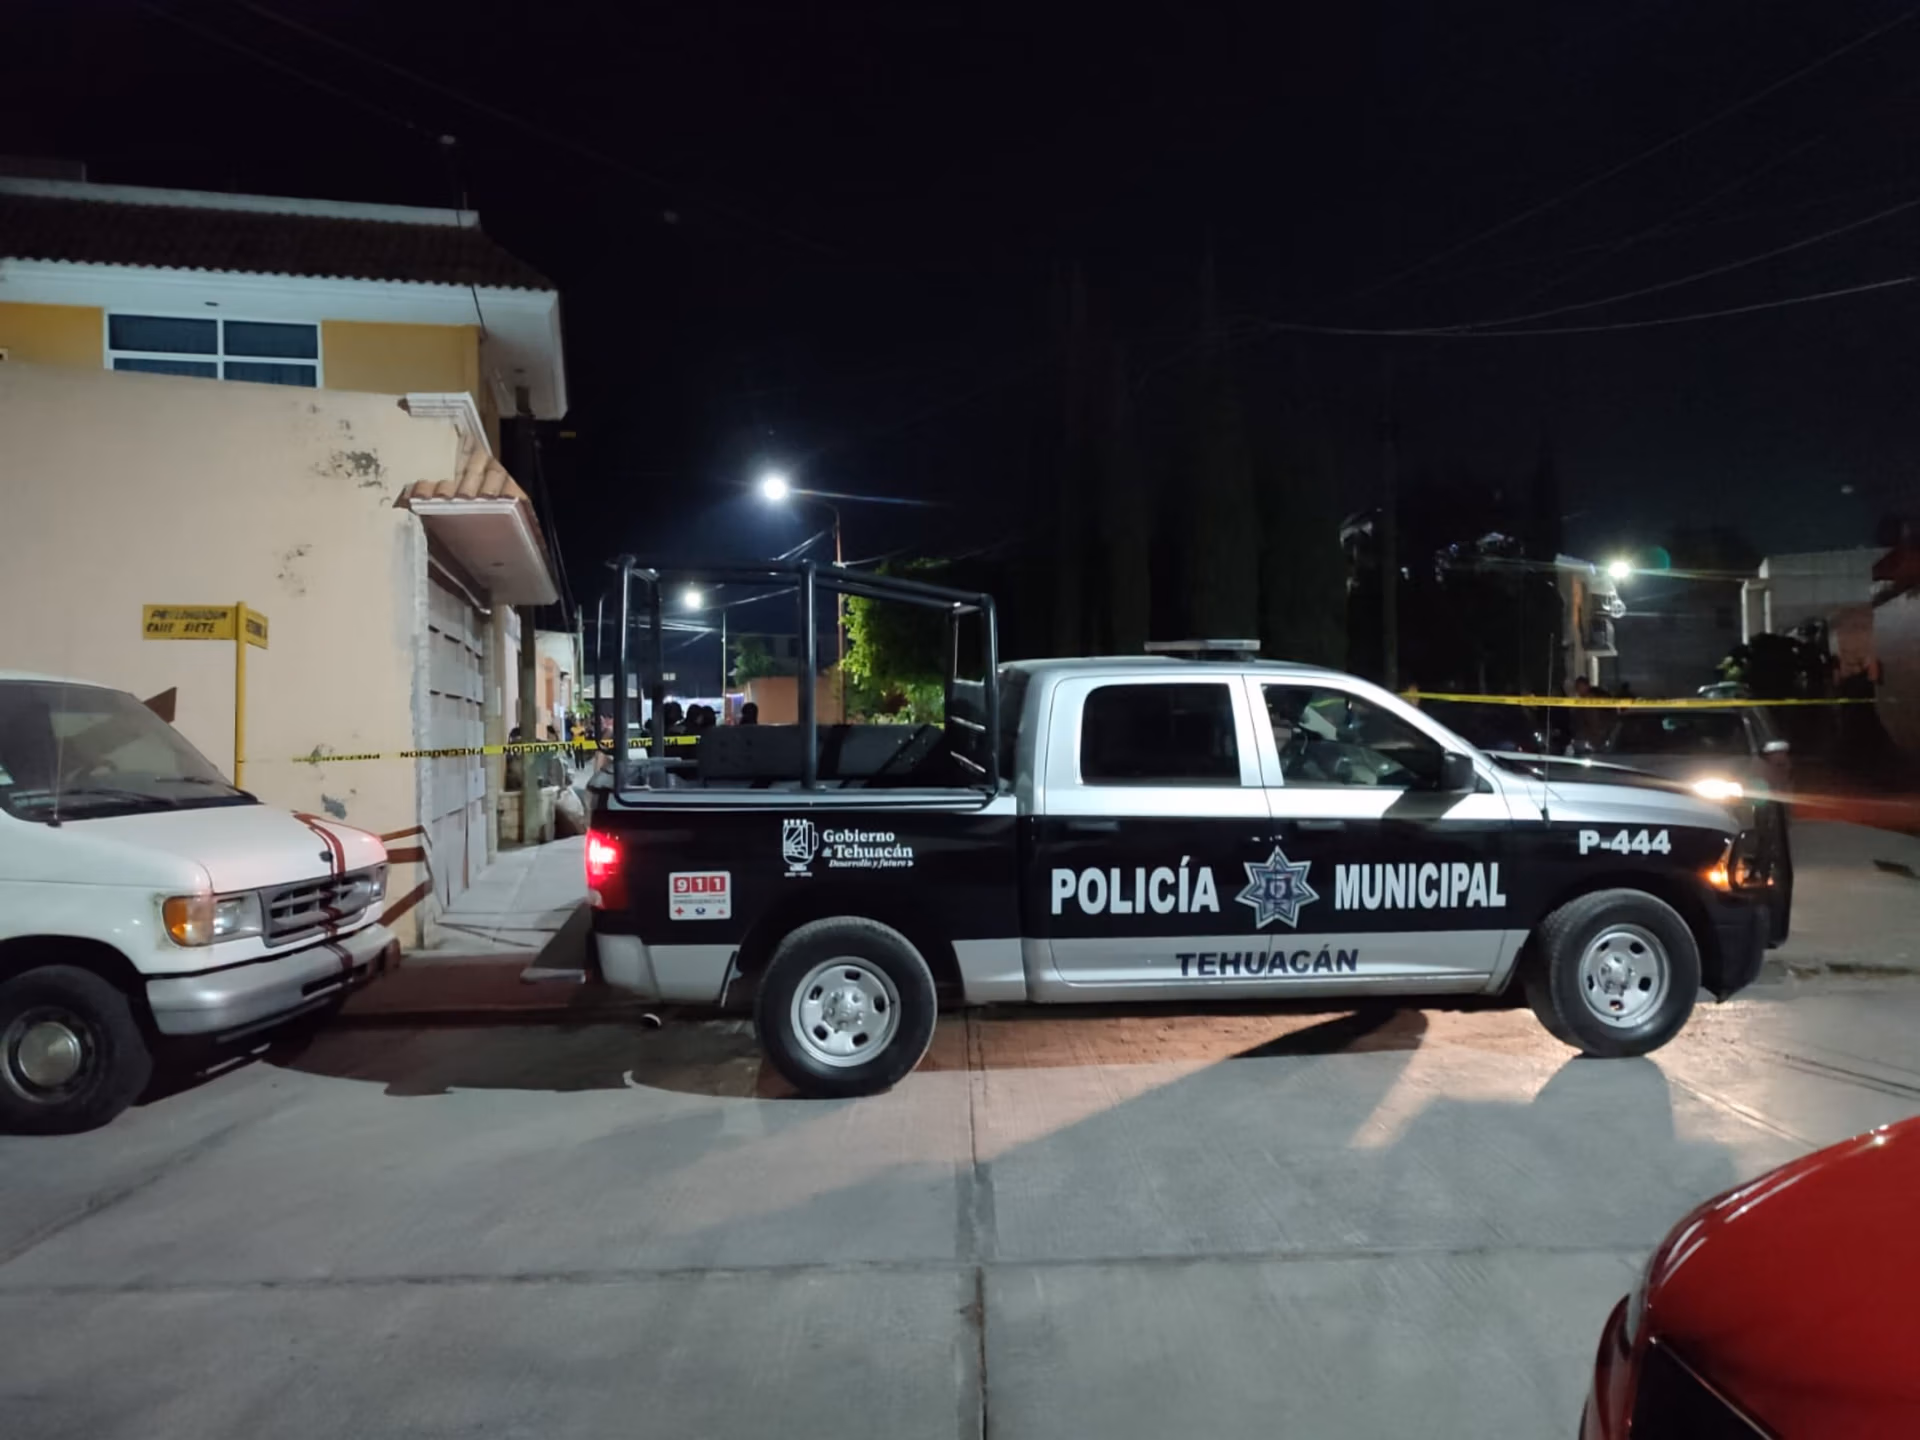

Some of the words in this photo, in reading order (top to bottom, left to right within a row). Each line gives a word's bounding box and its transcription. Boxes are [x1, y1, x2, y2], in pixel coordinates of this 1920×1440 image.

[400, 747, 484, 760] PRECAUCION
[503, 741, 583, 755] PRECAUCION
[822, 829, 895, 843] Gobierno
[1579, 829, 1672, 855] P-444
[833, 843, 913, 859] Tehuacán
[828, 860, 873, 868] Desarrollo
[878, 859, 907, 869] futuro
[676, 878, 722, 892] 911
[1052, 855, 1220, 914] POLICÍA
[1335, 862, 1506, 910] MUNICIPAL
[1176, 944, 1359, 976] TEHUACÁN
